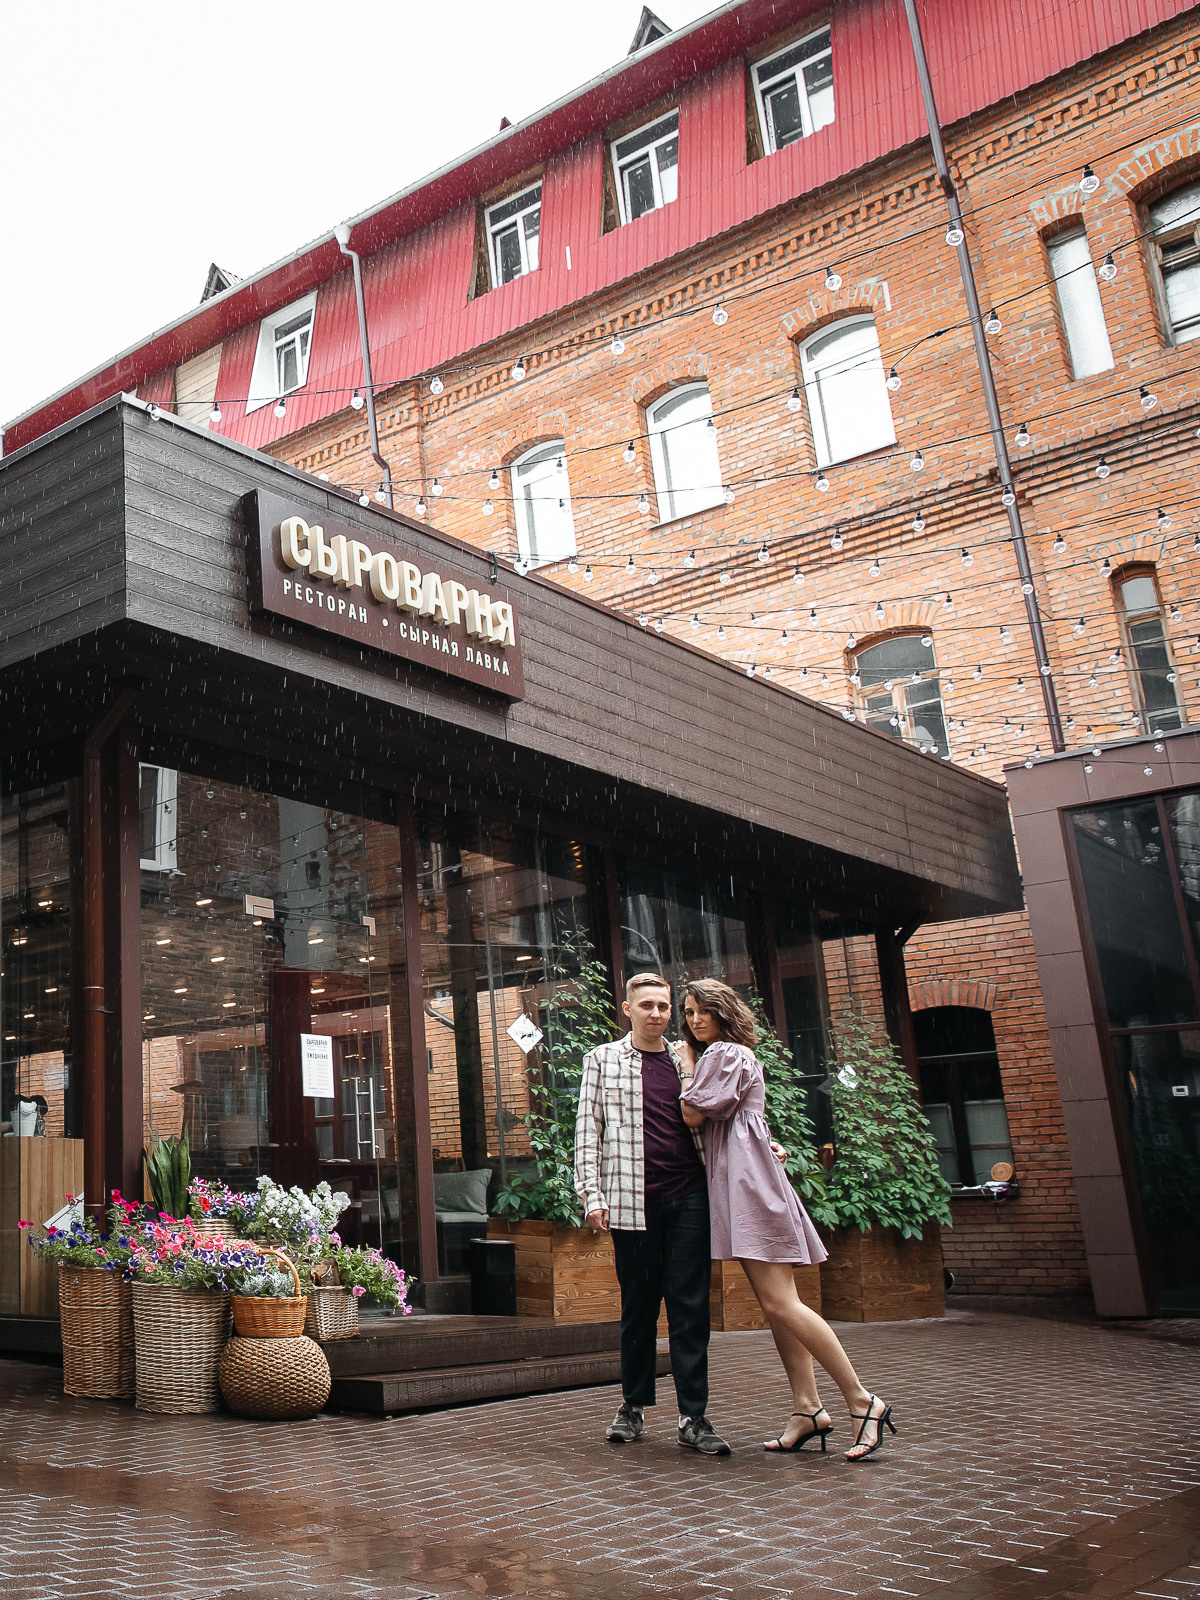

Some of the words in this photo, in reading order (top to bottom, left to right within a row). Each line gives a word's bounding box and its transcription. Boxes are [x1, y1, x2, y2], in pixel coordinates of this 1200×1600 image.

[280, 516, 515, 648] СЫРОВАРНЯ
[283, 578, 368, 624] РЕСТОРАН
[399, 621, 459, 658] СЫРНАЯ
[466, 647, 510, 676] ЛАВКА
